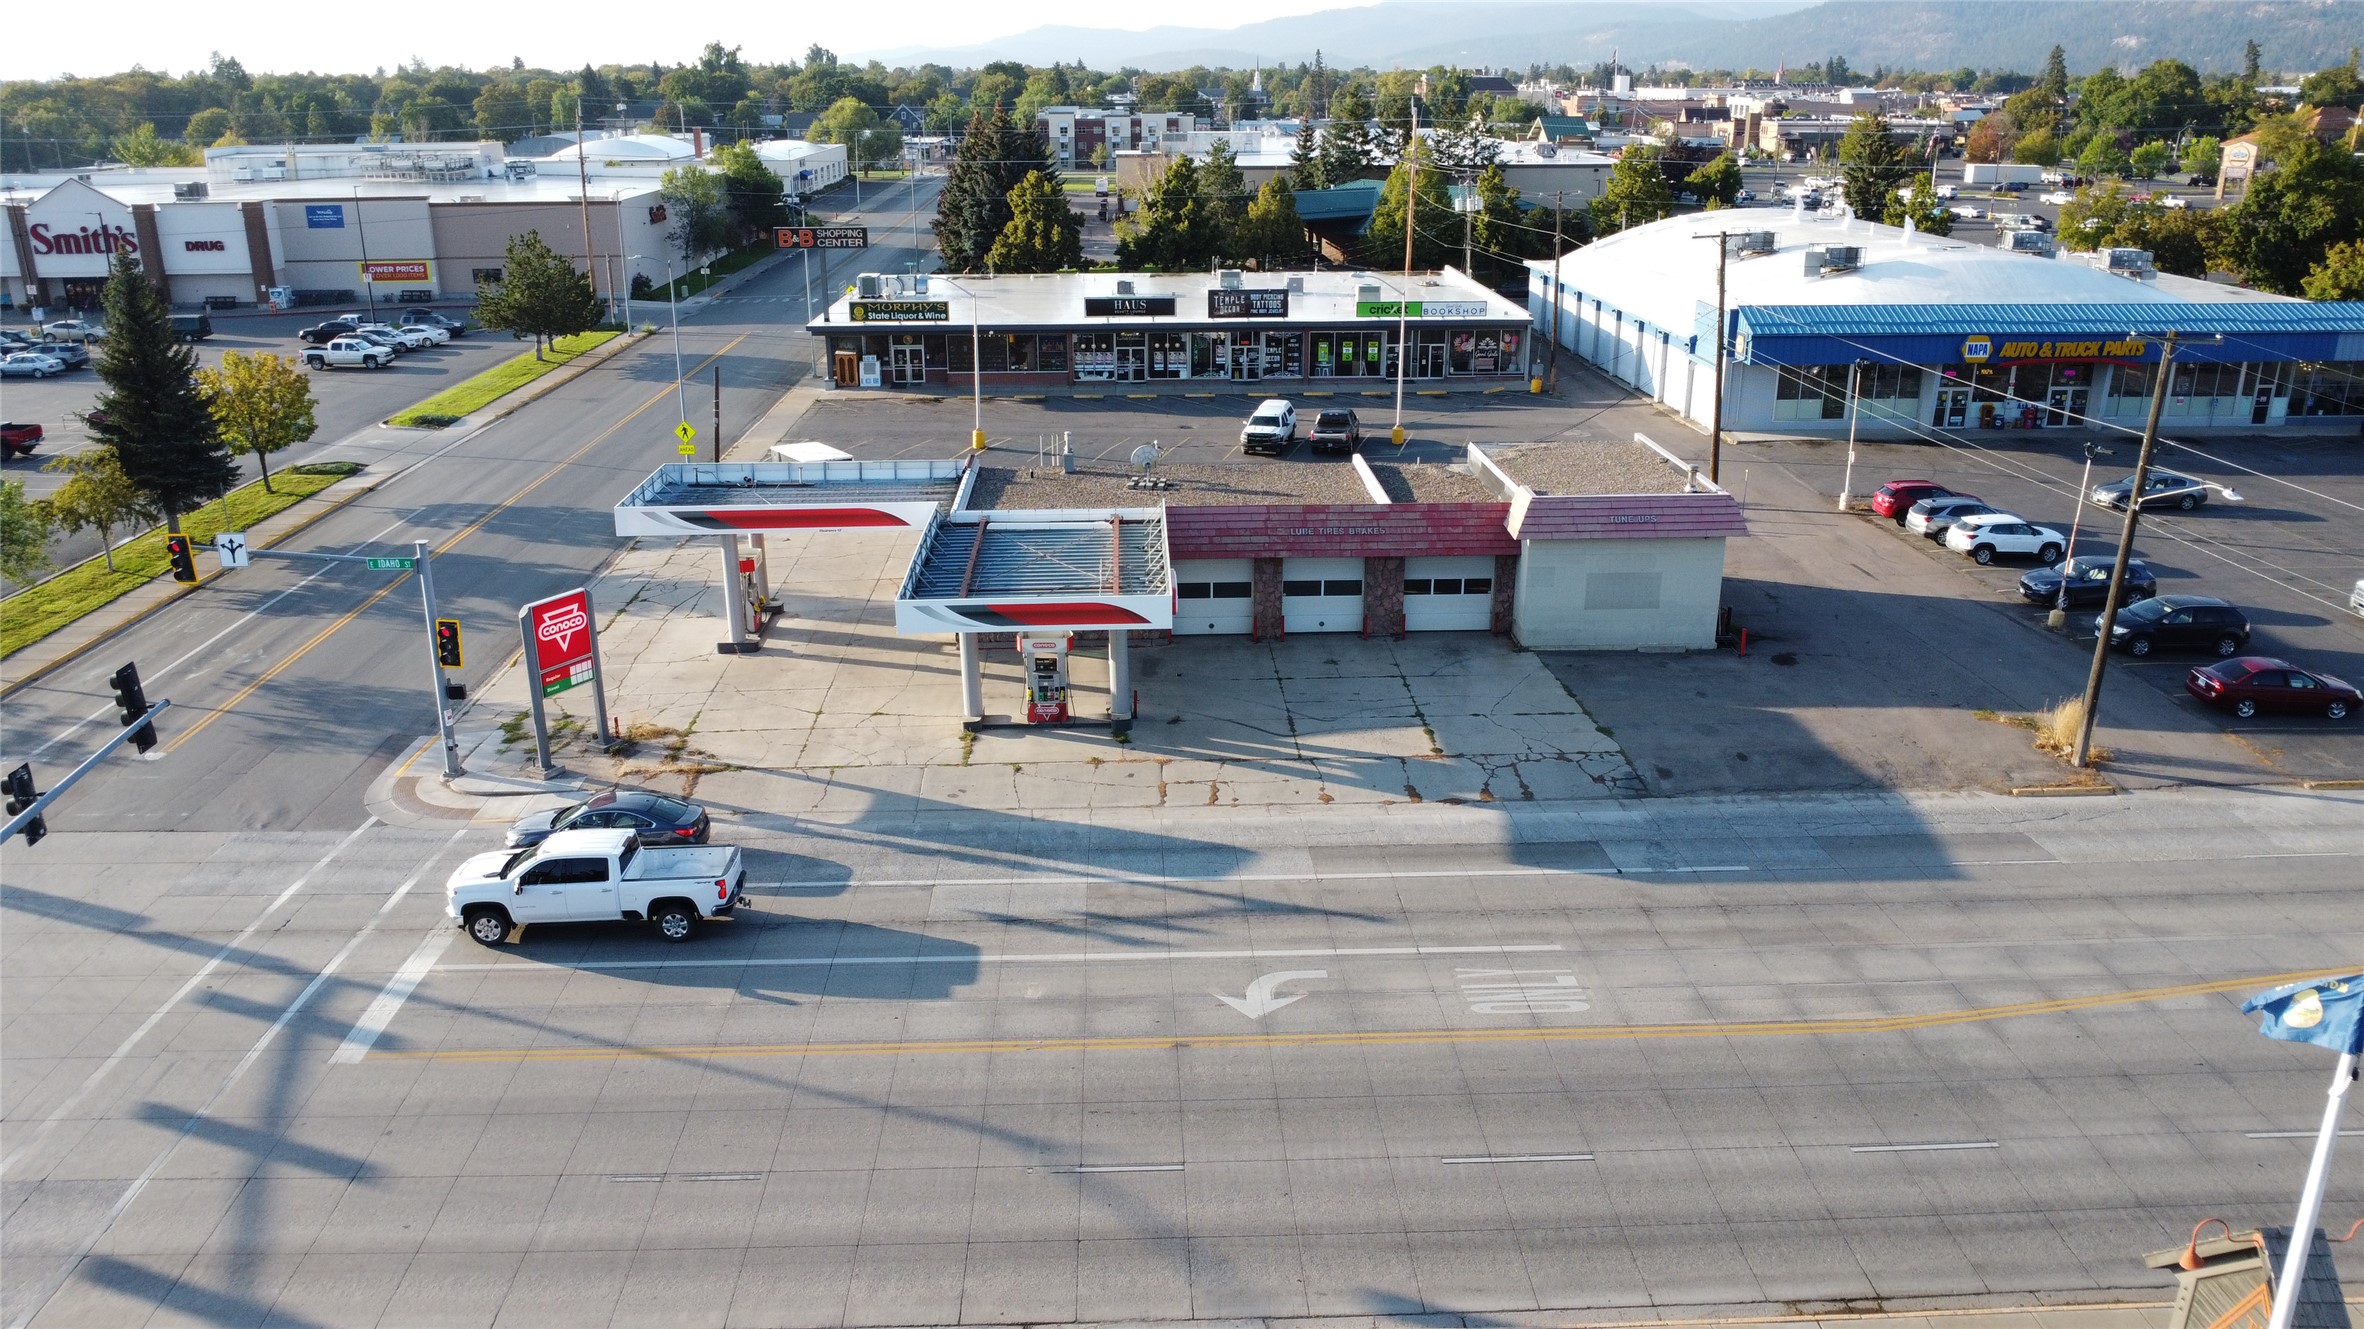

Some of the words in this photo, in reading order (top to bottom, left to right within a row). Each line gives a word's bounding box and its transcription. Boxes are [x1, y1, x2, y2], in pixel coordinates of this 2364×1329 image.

[778, 229, 814, 247] B&B
[816, 229, 863, 238] SHOPPING
[30, 223, 138, 255] Smith's
[816, 238, 864, 247] CENTER
[185, 240, 225, 252] DRUG
[1114, 300, 1147, 309] HAUS
[1213, 295, 1246, 307] TEMPLE
[1253, 300, 1281, 308] TATTOOS
[866, 303, 946, 311] MURPHY'S
[1369, 304, 1409, 314] cricket
[1423, 307, 1485, 315] BOOKSHOP
[868, 312, 890, 320] State
[890, 312, 917, 321] Liquor
[924, 312, 946, 320] Wine
[1967, 343, 1989, 356] NAPA
[1999, 342, 2038, 358] AUTO
[2039, 342, 2054, 357] &
[2054, 342, 2102, 357] TRUCK
[2102, 341, 2146, 357] PARTS
[1609, 515, 1634, 523] TUNE
[1638, 515, 1657, 523] UPS
[1290, 527, 1315, 536] LUBE
[1318, 527, 1345, 535] TIRES
[1348, 527, 1386, 535] BRAKES
[377, 559, 401, 568] IDAHO
[1454, 967, 1591, 1014] ONLY
